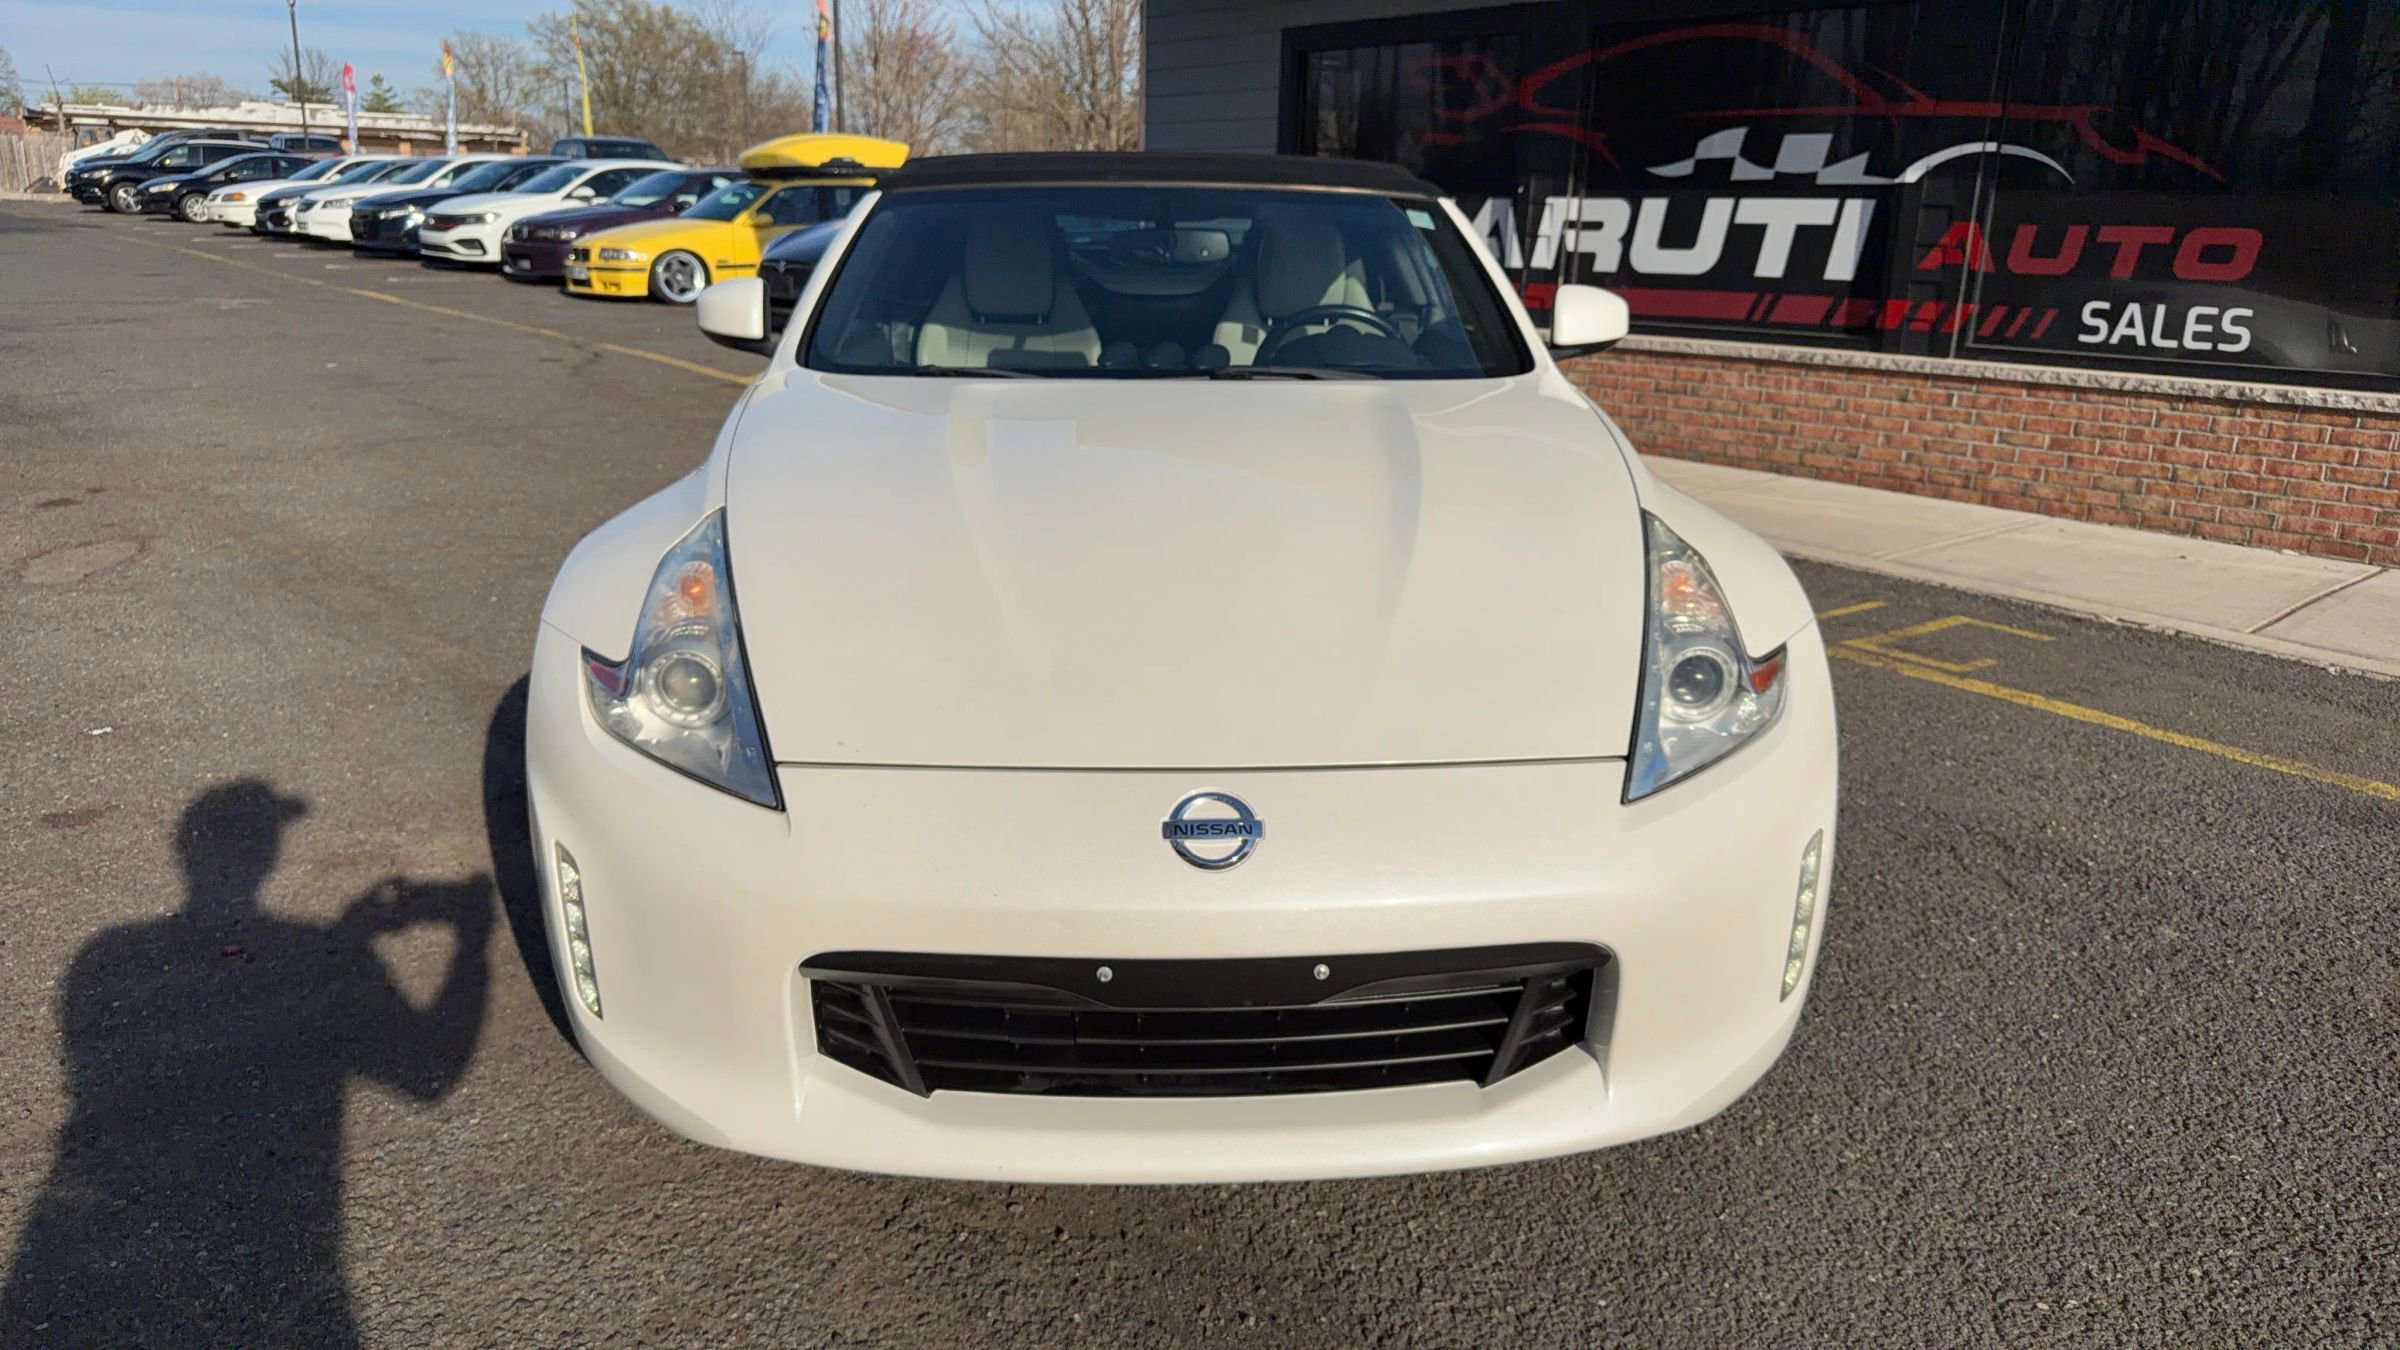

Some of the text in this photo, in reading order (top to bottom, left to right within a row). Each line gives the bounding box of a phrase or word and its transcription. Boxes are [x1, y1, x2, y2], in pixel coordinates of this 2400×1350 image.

[1917, 222, 2263, 281] AUTO
[2077, 300, 2254, 352] SALES
[1174, 823, 1253, 836] NISSAN
